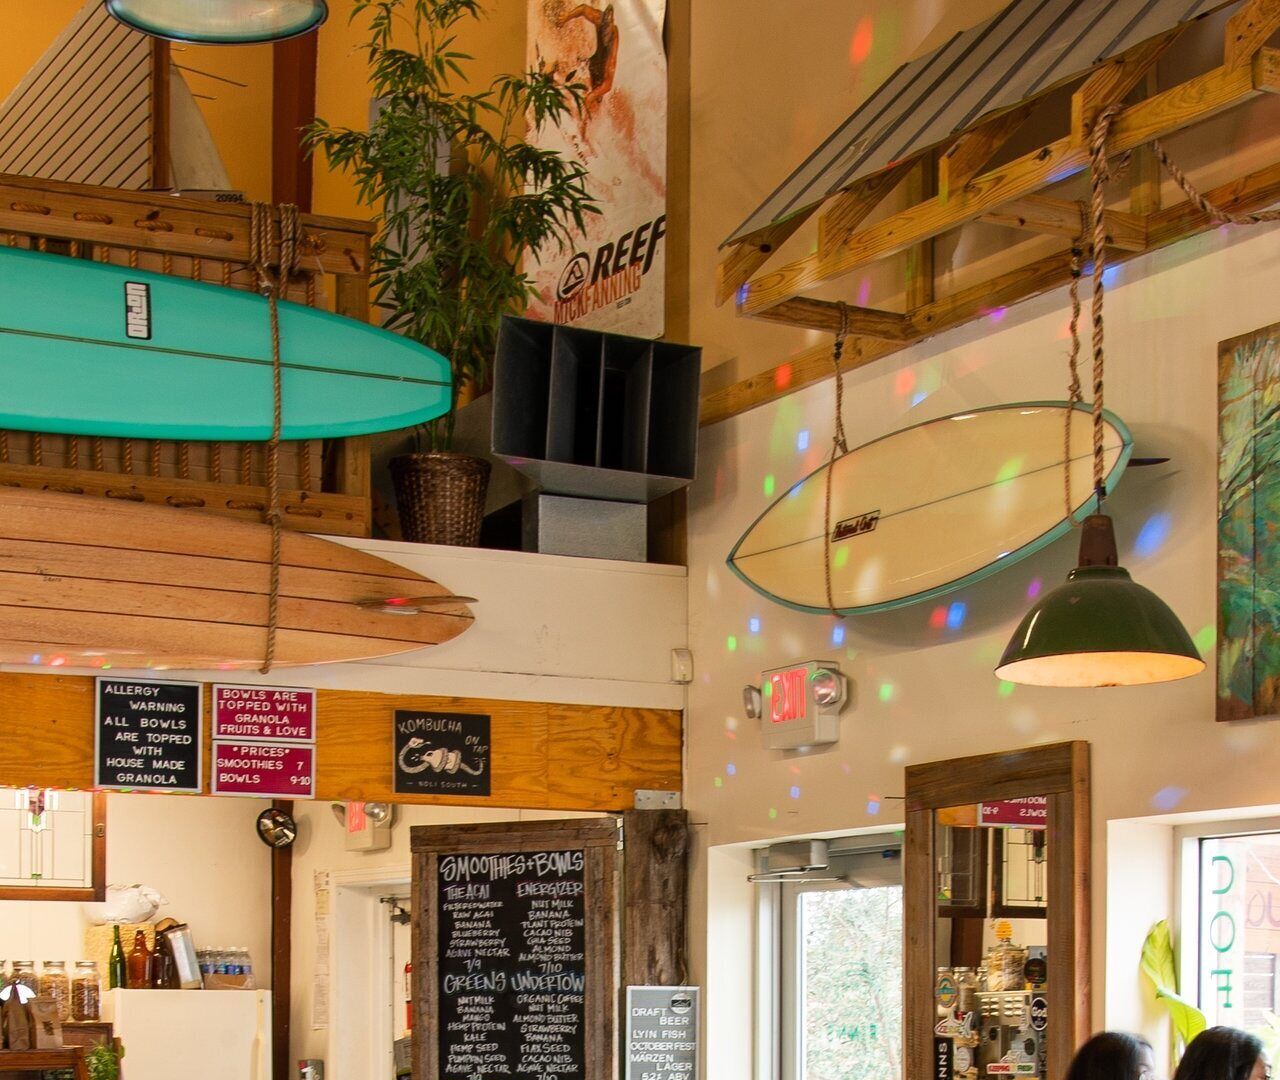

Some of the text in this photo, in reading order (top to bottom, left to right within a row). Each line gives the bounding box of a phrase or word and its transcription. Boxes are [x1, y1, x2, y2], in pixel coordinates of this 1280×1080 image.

[590, 214, 666, 285] REEF
[104, 685, 160, 697] ALLERGY
[223, 690, 298, 701] BOWLS ARE
[771, 668, 808, 723] EXIT
[129, 701, 185, 712] WARNING
[219, 701, 306, 712] TOPPED WITH
[104, 717, 186, 729] ALL BOWLS
[235, 714, 289, 724] GRANOLA
[220, 725, 259, 734] FRUITS
[276, 727, 306, 736] LOVE
[398, 719, 462, 734] KOMBUCHA
[115, 733, 192, 745] ARE TOPPED
[465, 736, 480, 745] ON
[133, 746, 162, 756] WITH
[241, 747, 284, 756] PRICES
[106, 758, 185, 770] HOUSE MADE
[217, 759, 303, 771] SMOOTHIES 7
[117, 773, 177, 784] GRANOLA
[220, 774, 311, 785] BOWLS 9-10
[440, 854, 526, 881] SMOOTHIES
[533, 852, 583, 877] BOWLS
[516, 881, 583, 897] ENERGIZER
[444, 971, 506, 994] GREENS
[511, 971, 584, 991] UNDERTOW
[632, 1008, 667, 1016] DRAFT
[660, 1017, 689, 1025] BEER
[633, 1030, 686, 1039] LYIN FISH
[656, 1063, 692, 1071] LAGER
[668, 1073, 690, 1080] ABV
